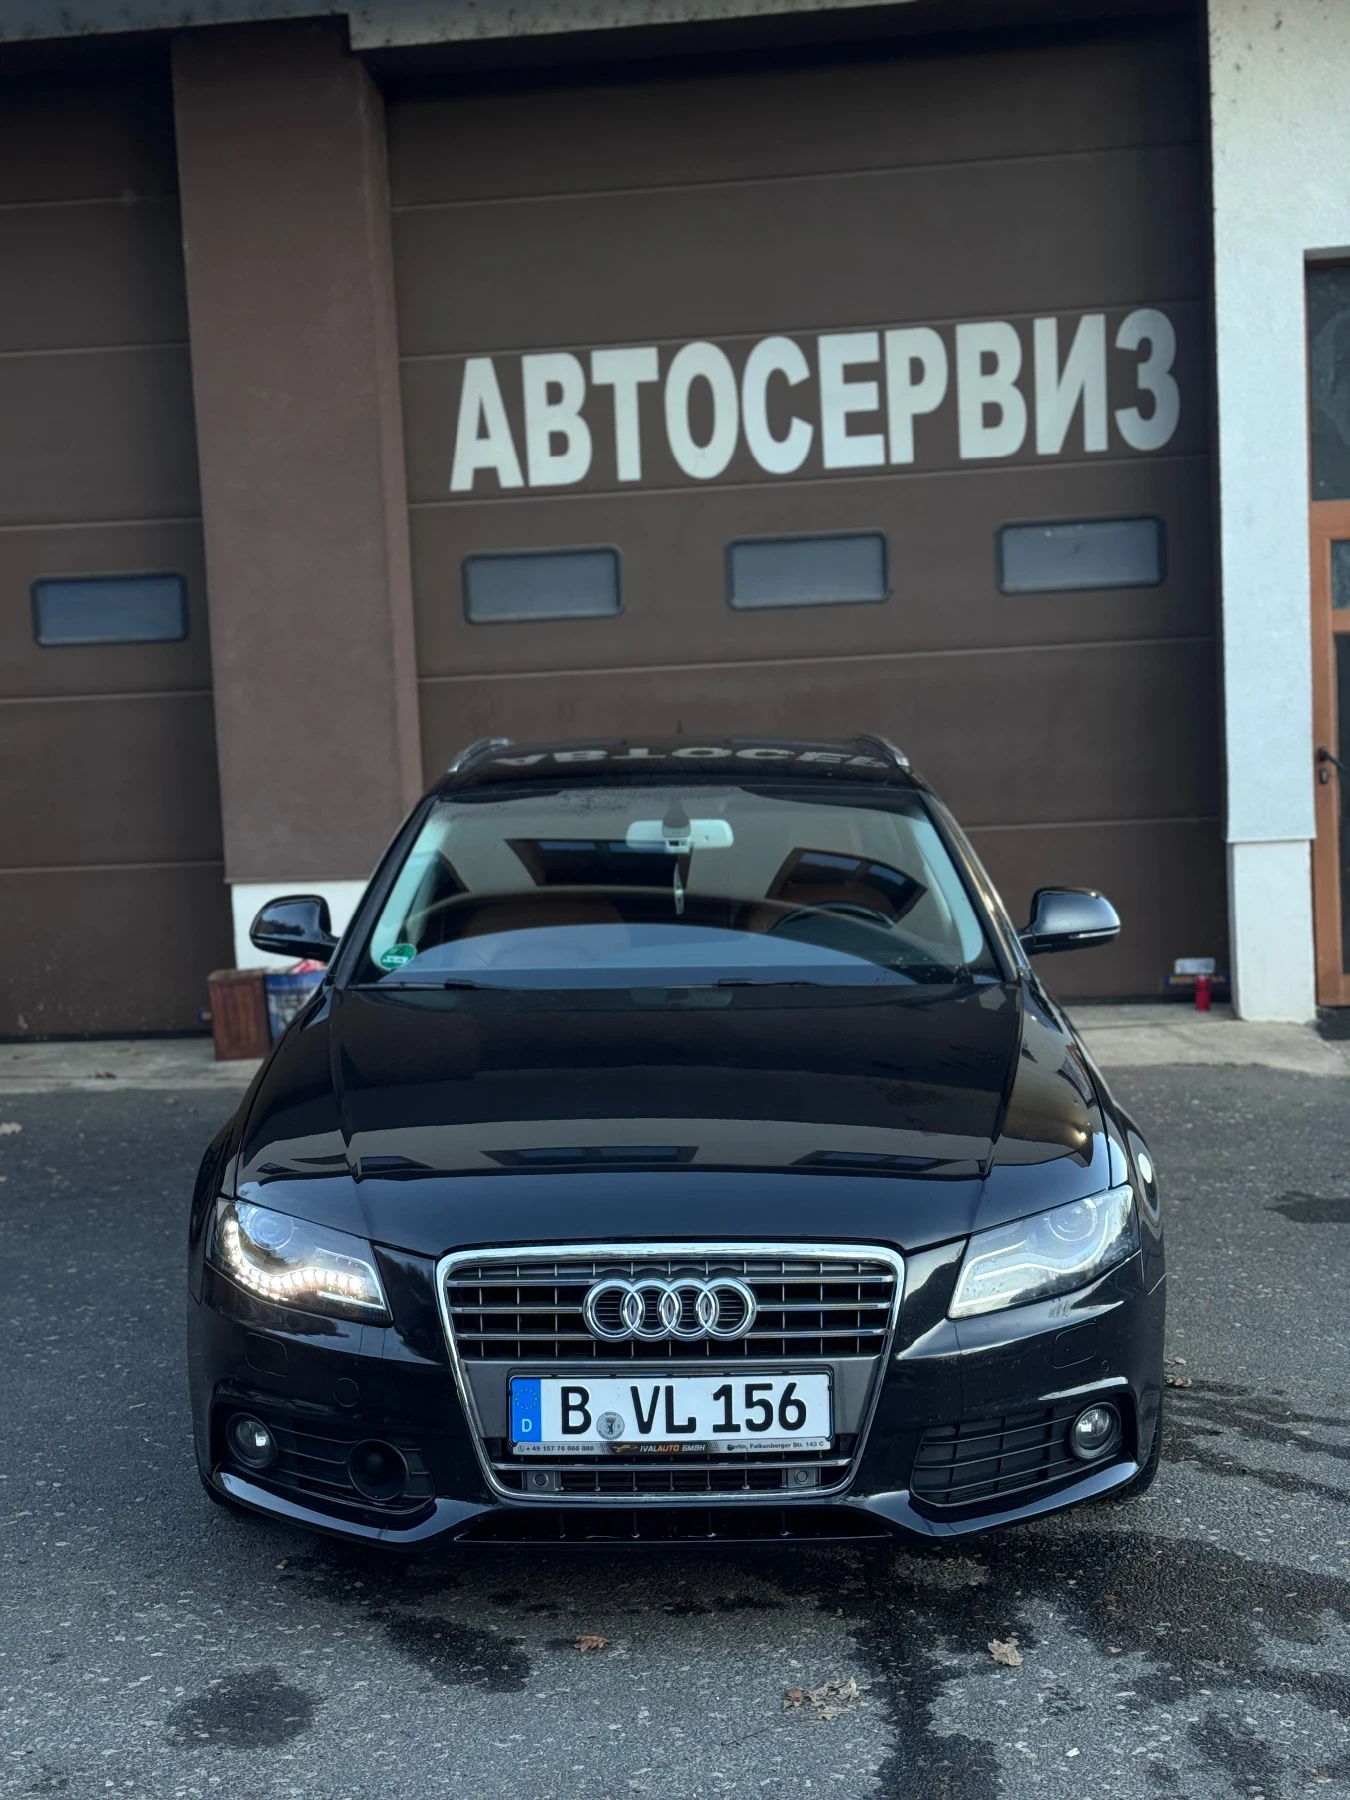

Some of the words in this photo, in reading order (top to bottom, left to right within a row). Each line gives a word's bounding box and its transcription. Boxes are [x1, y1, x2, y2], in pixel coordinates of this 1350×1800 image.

[450, 307, 1181, 492] АВТОСЕРВИЗ
[521, 1418, 533, 1433] D
[560, 1385, 592, 1435] B
[630, 1384, 697, 1434] VL
[712, 1382, 807, 1433] 156
